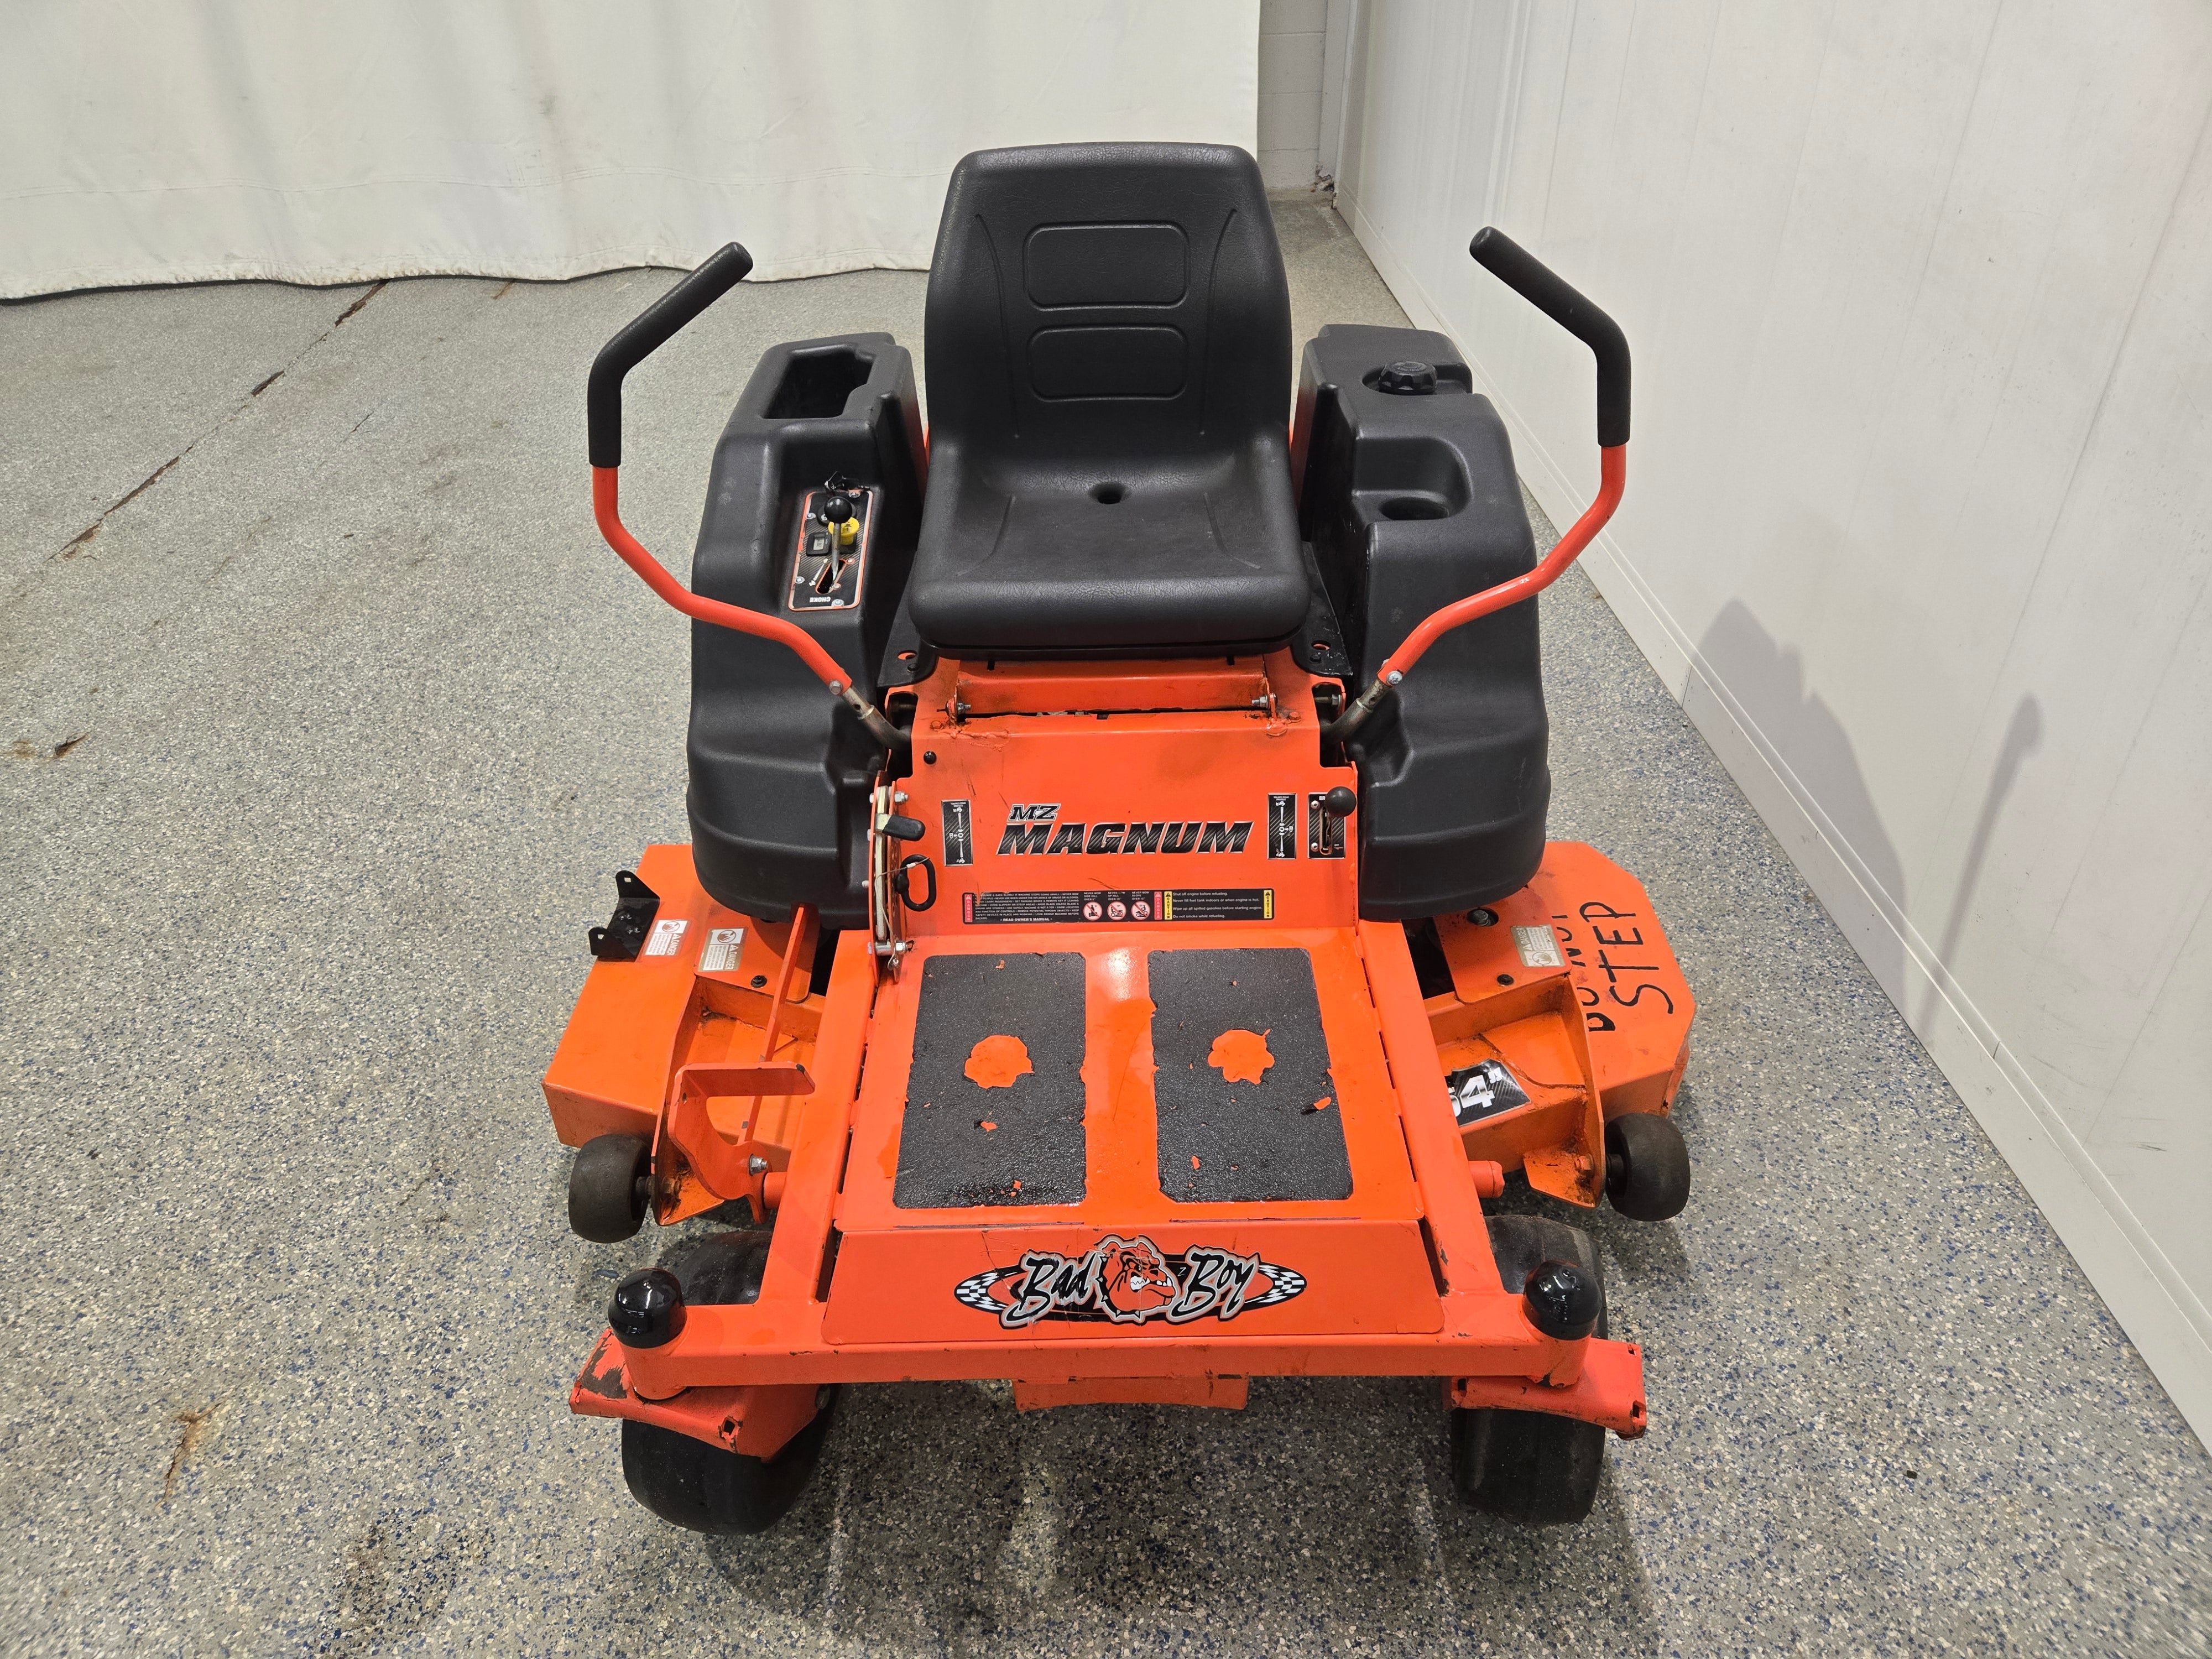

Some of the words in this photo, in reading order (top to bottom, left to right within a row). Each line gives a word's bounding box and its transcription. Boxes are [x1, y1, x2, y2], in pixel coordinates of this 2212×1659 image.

[1009, 805, 1058, 820] MZ
[997, 822, 1254, 855] MAGNUM
[1516, 927, 1530, 944] DANGER
[667, 940, 679, 956] DANGER
[725, 952, 738, 970] DANGER
[1579, 902, 1673, 1014] STEP
[1006, 1252, 1097, 1321] Bad
[1171, 1251, 1254, 1317] Boy
